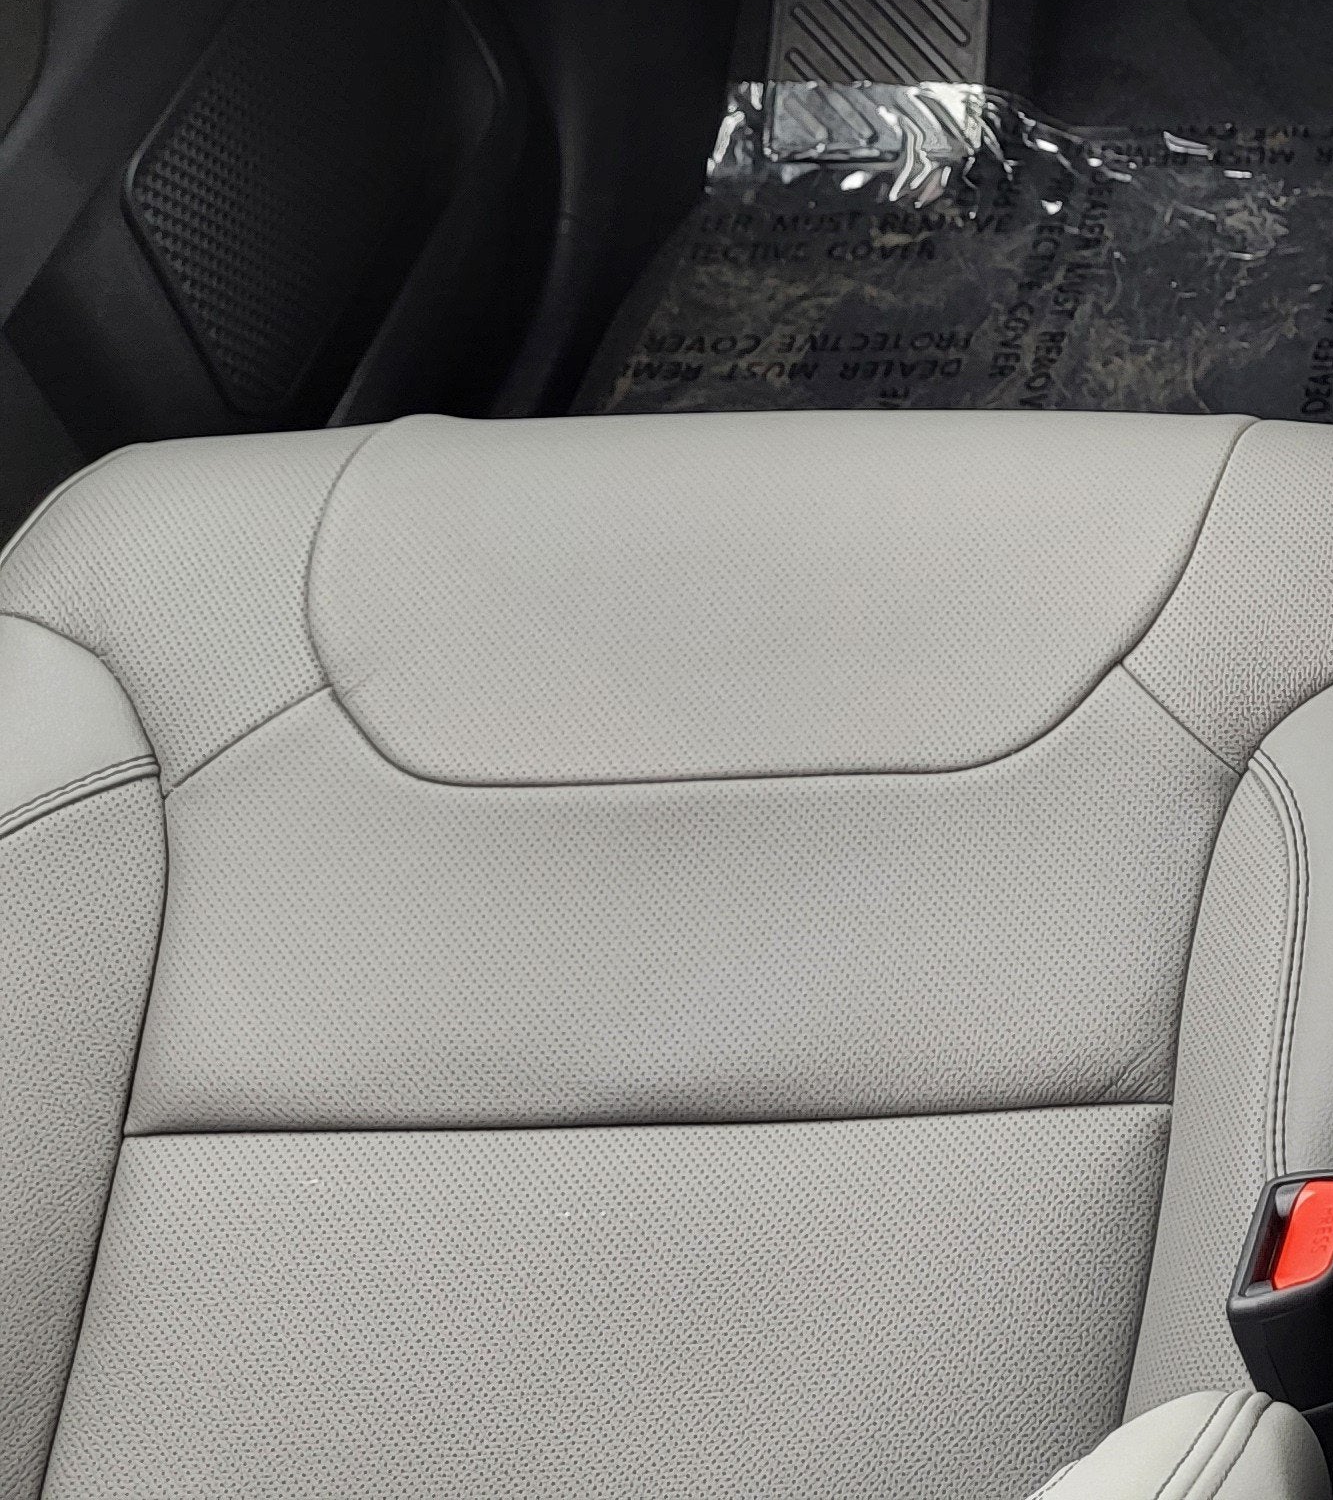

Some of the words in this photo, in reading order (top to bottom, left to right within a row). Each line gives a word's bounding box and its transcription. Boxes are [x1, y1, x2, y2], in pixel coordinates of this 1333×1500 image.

[643, 332, 762, 353] COVER
[777, 331, 973, 351] PROTECTIVE
[719, 360, 819, 383] MUST
[838, 358, 963, 381] DEALER
